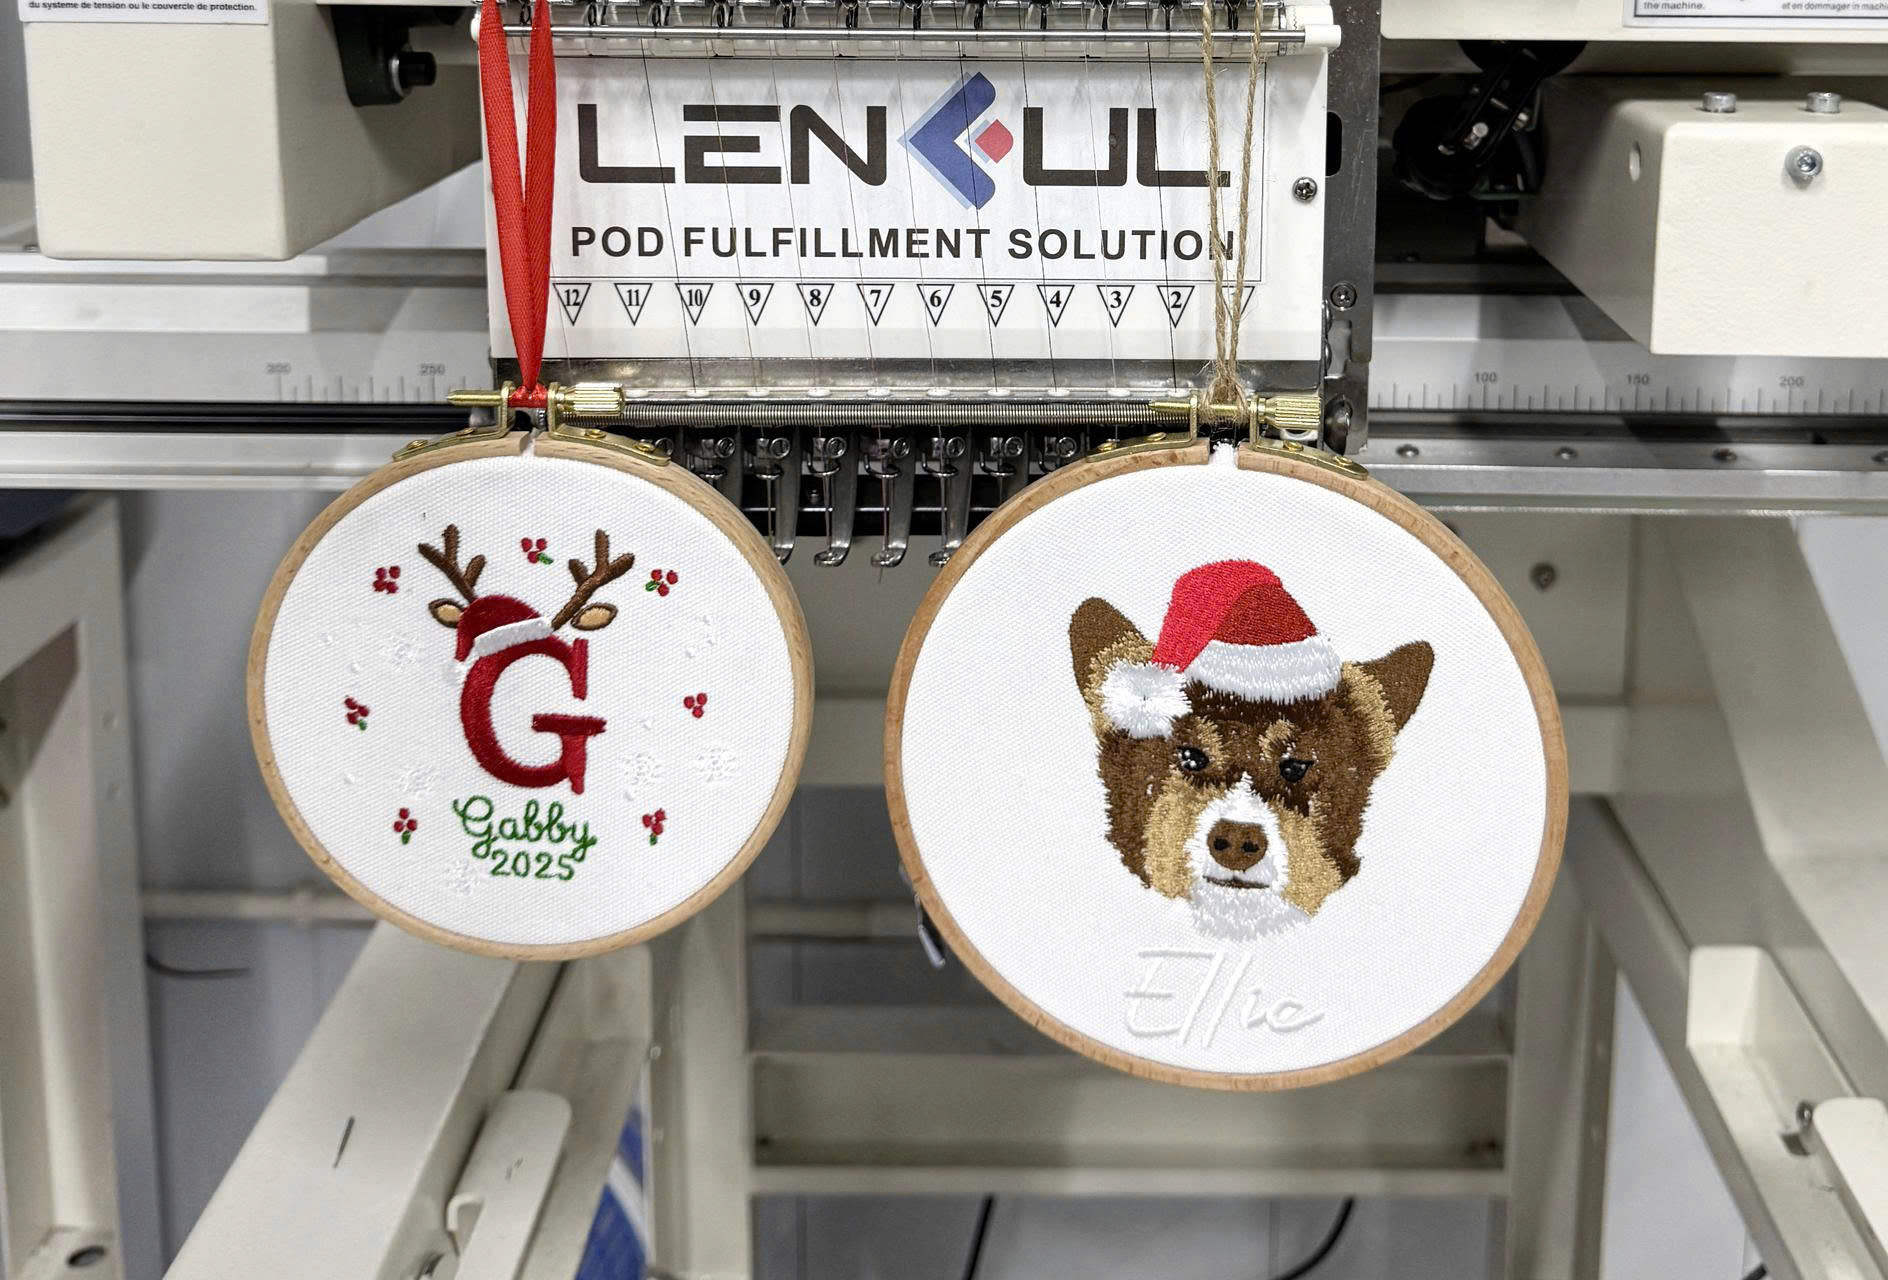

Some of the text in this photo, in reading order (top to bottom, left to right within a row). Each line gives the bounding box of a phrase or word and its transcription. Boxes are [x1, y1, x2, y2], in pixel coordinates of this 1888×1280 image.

[1661, 2, 1705, 10] machine.
[572, 226, 1234, 261] POD FULFILLMENT SOLUTION
[565, 289, 1183, 308] 12 11 10 9 8 7 6 5 4 3 2
[1474, 371, 1497, 383] 100
[1779, 376, 1804, 387] 200
[460, 634, 607, 795] G
[453, 795, 598, 863] Gabby
[490, 848, 577, 881] 2025
[1122, 948, 1325, 1048] Ellie
